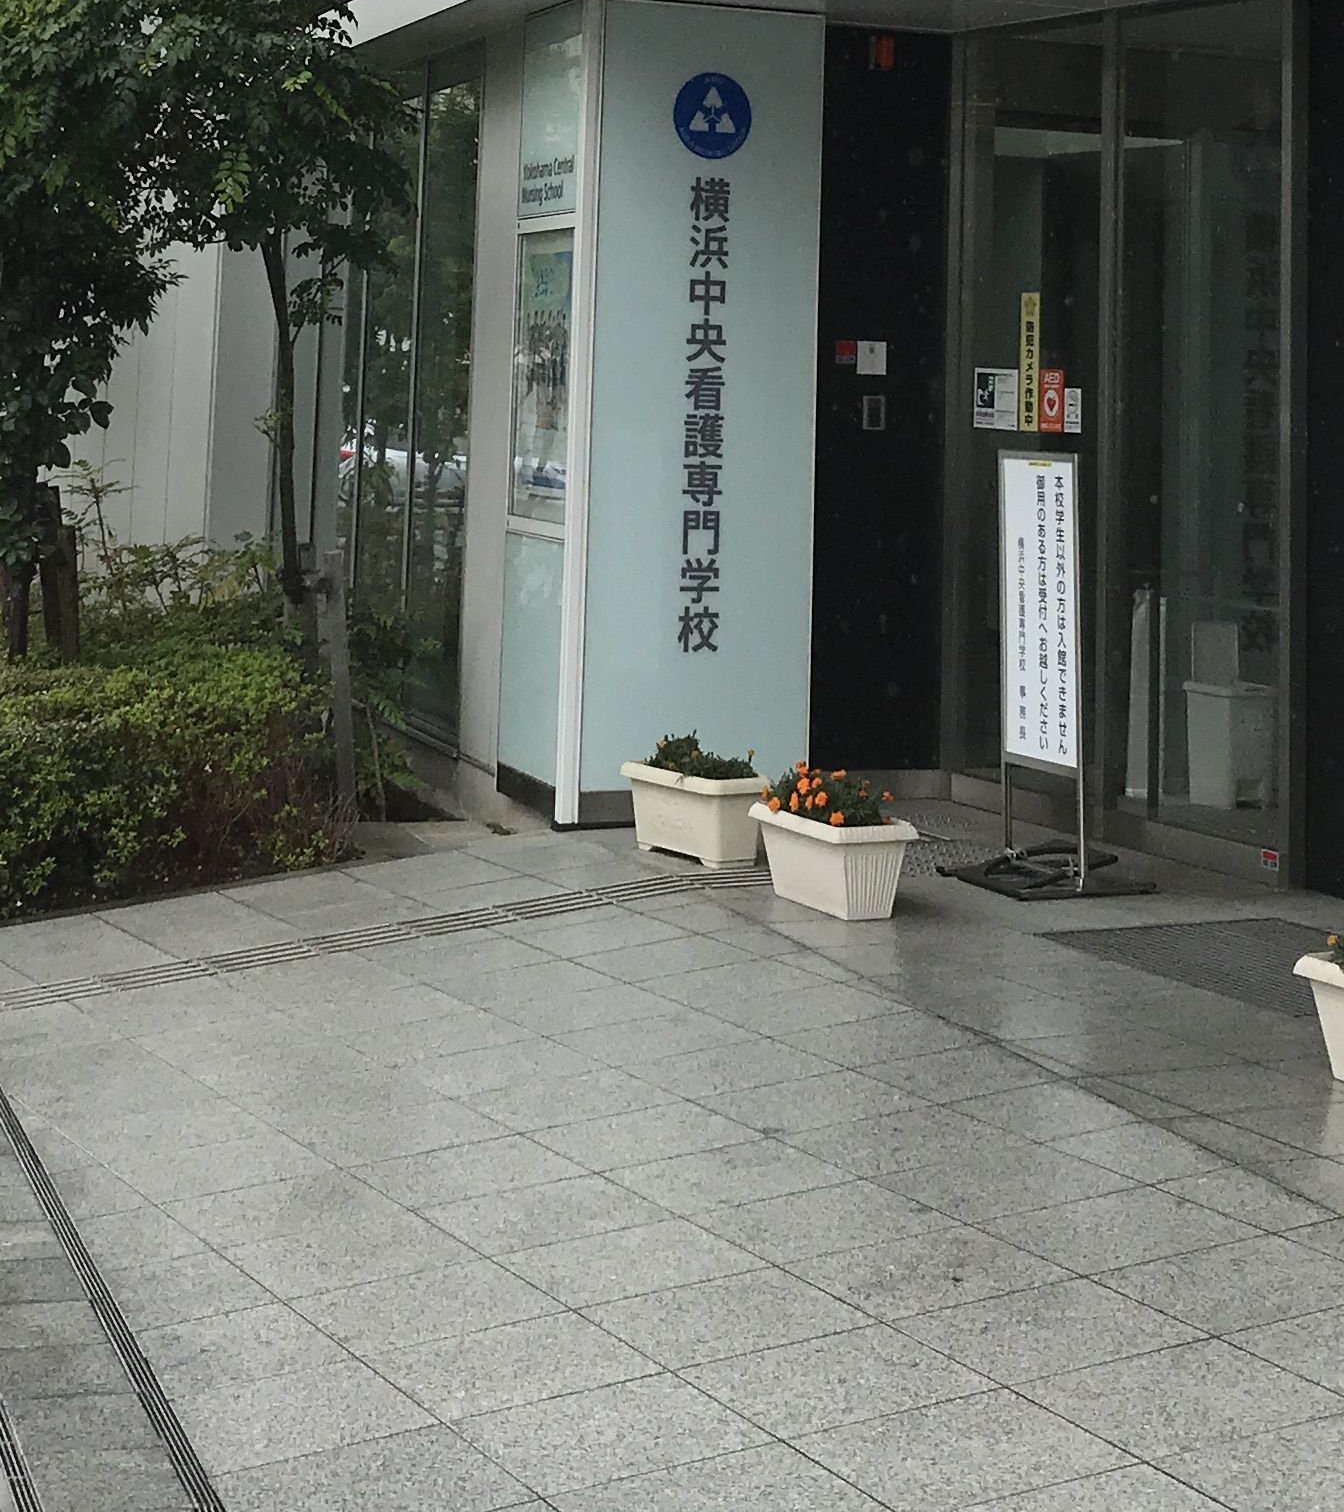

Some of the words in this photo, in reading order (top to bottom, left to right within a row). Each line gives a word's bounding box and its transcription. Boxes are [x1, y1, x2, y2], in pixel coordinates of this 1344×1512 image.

[677, 176, 731, 653] 横浜中央看護専門学校
[1025, 320, 1035, 427] 防犯カメラ作動中
[1044, 372, 1060, 384] AED
[1054, 476, 1068, 755] 本校学生以外の方は入館できません
